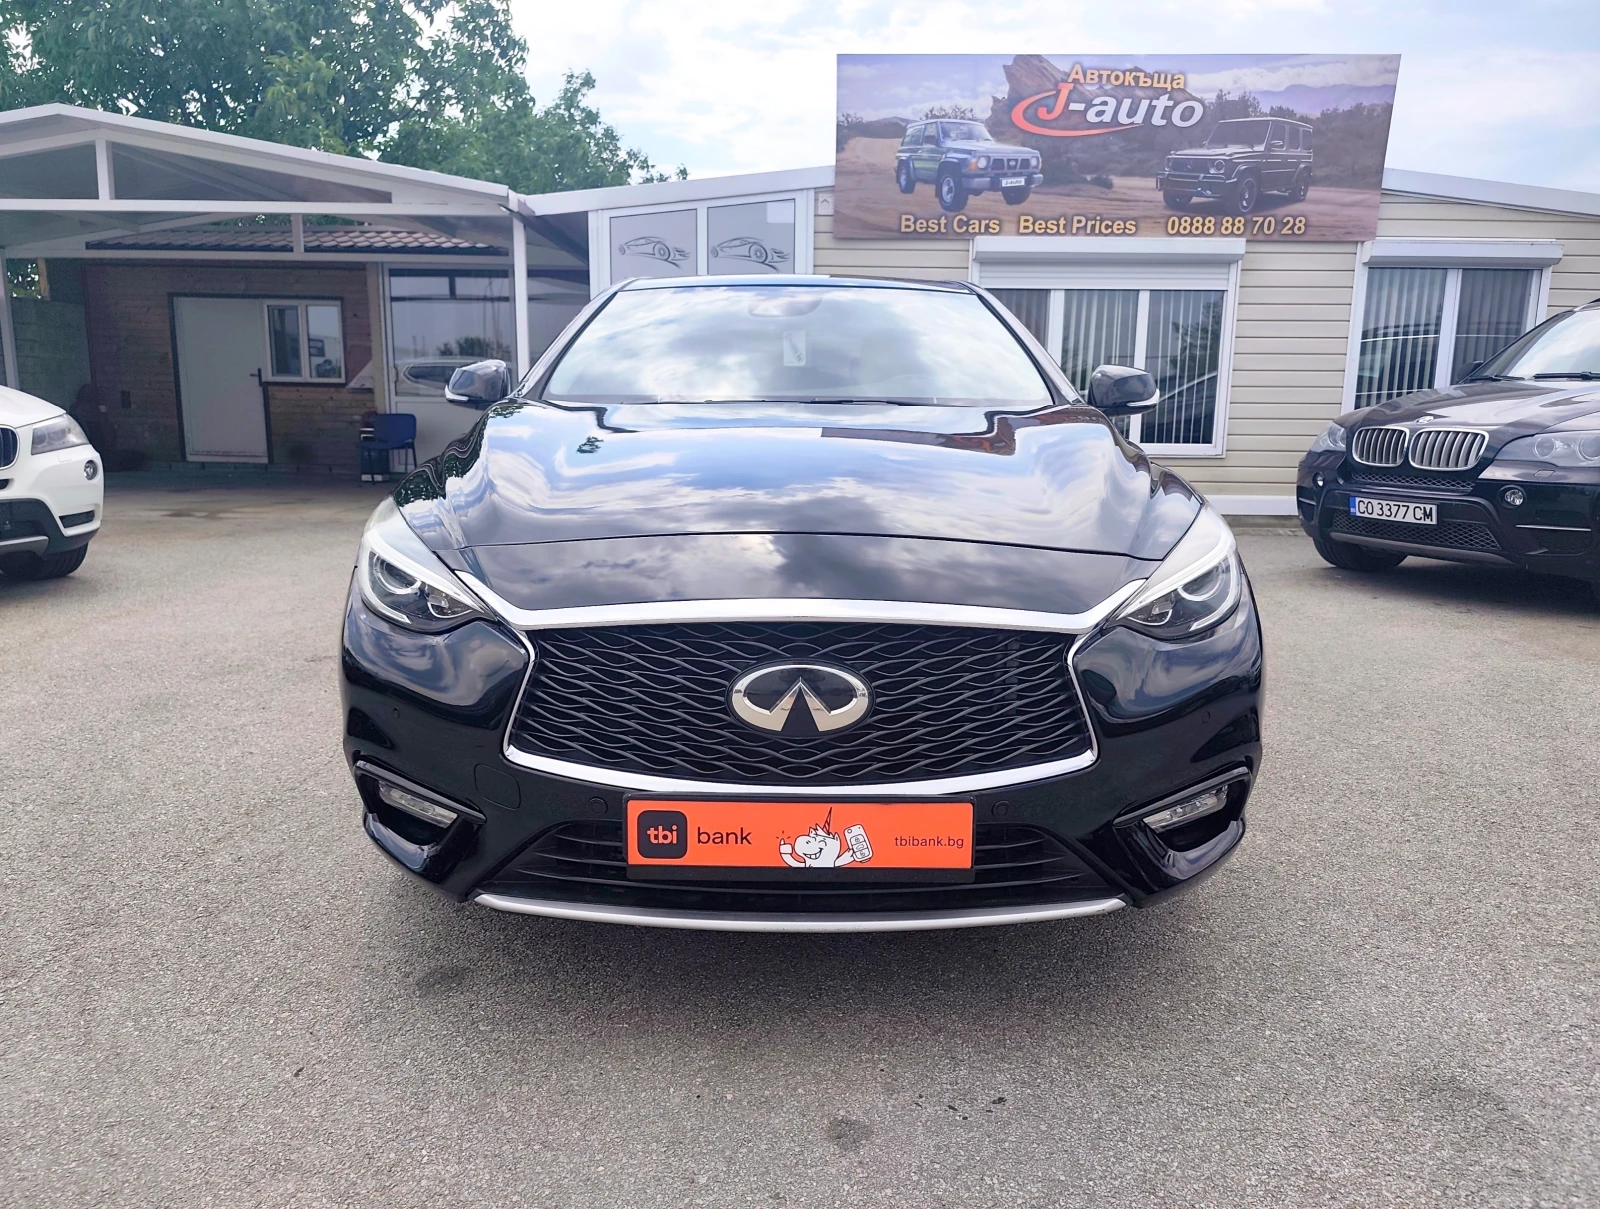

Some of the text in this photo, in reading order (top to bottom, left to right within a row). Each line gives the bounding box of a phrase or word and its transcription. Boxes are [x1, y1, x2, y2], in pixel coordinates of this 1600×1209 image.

[1067, 64, 1186, 91] Автокъща
[1036, 82, 1204, 128] J-auto
[900, 214, 1001, 233] Best Cars
[1018, 215, 1137, 234] Best Prices
[1167, 216, 1306, 235] 0888 88 70 28
[1376, 502, 1410, 519] 3377
[1412, 505, 1433, 522] CM
[646, 824, 752, 845] tbi bank
[894, 835, 965, 849] tbibank.bg
